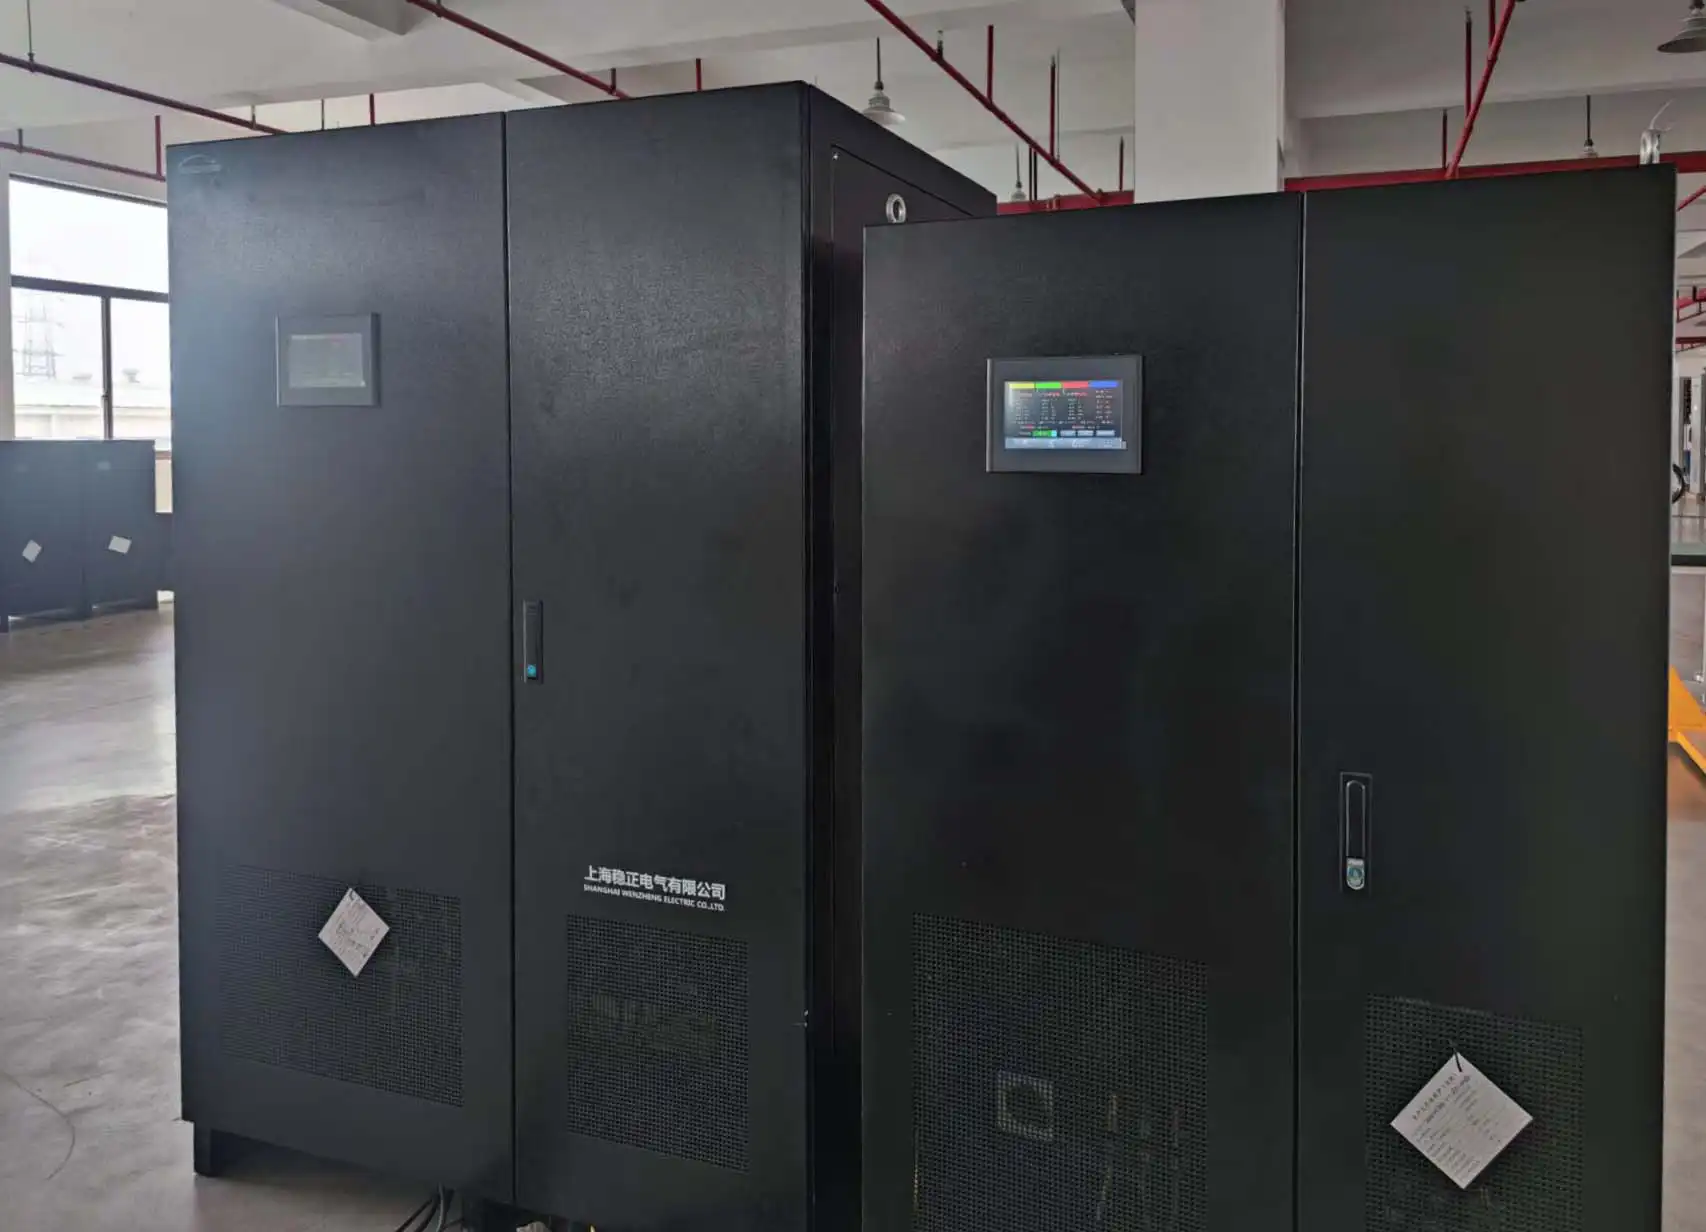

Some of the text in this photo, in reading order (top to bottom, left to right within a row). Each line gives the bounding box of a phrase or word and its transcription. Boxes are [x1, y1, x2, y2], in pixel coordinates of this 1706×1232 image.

[583, 865, 726, 900] 上海稳正电气有限公司
[583, 884, 620, 896] SHANGHAI
[621, 890, 662, 902] WENZHENG
[664, 896, 695, 907] ELECTRIC
